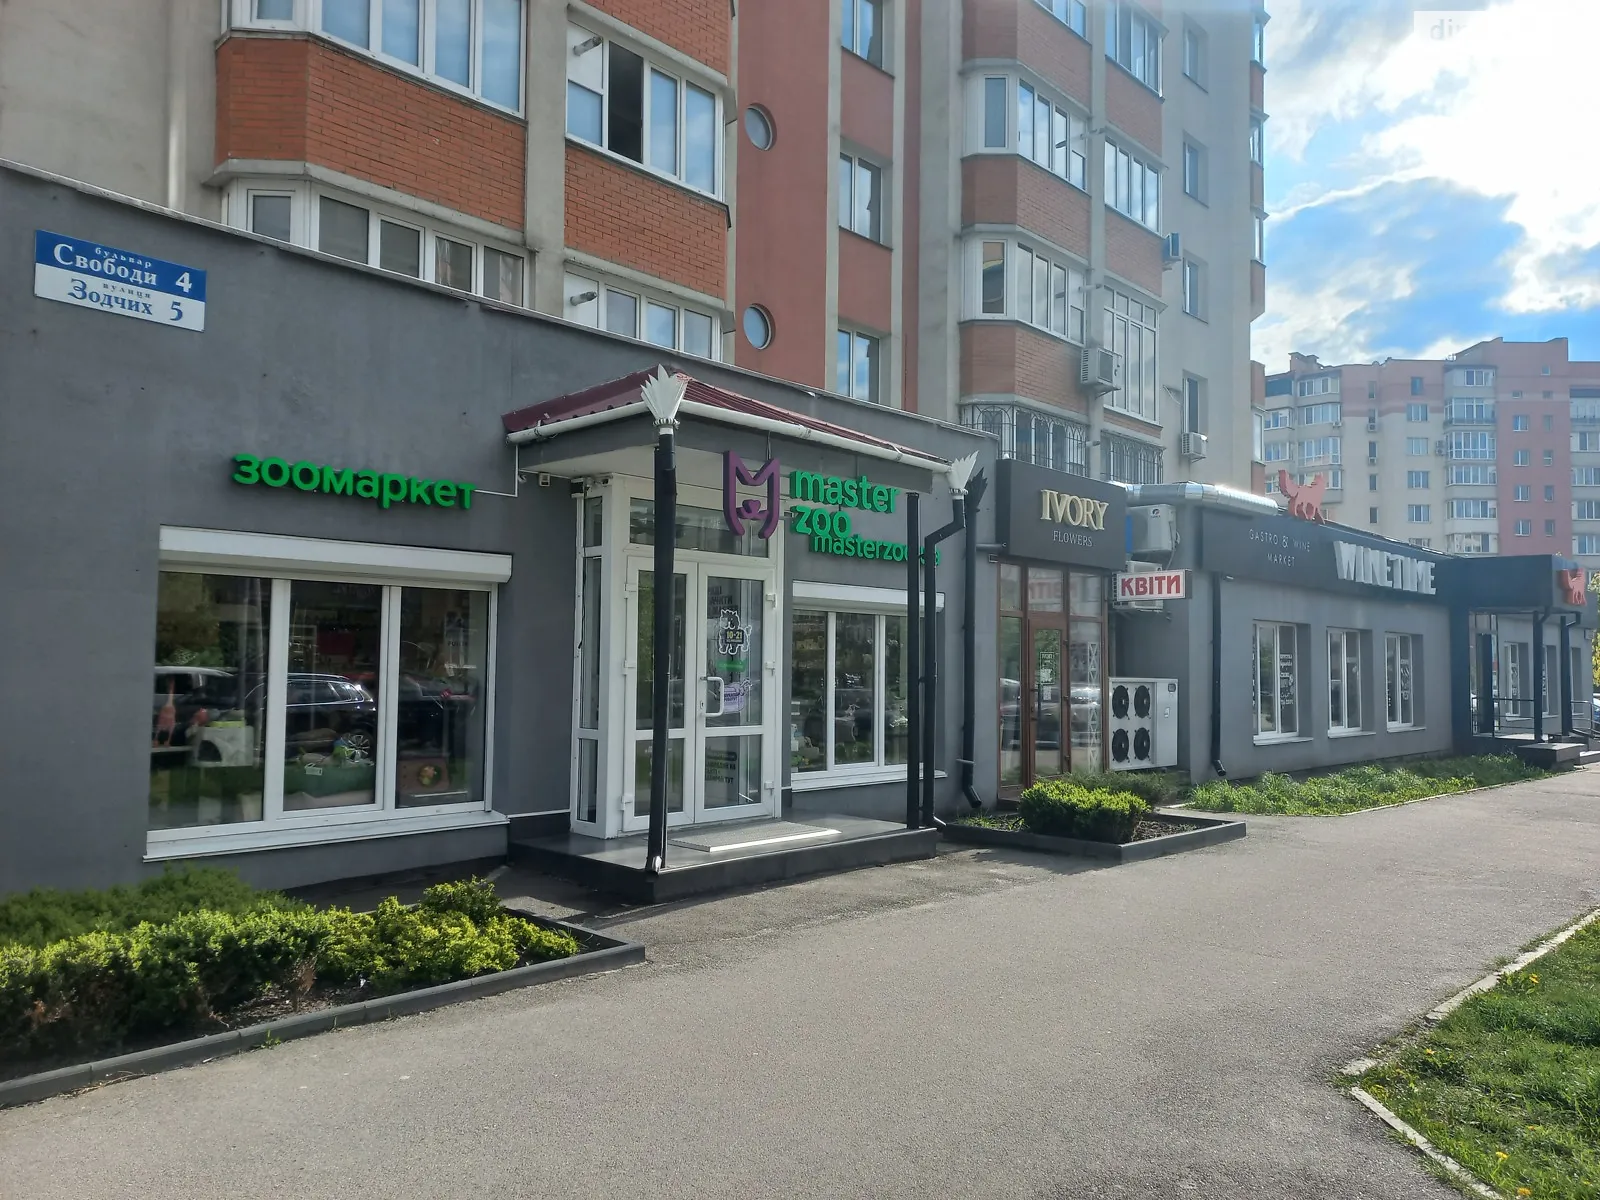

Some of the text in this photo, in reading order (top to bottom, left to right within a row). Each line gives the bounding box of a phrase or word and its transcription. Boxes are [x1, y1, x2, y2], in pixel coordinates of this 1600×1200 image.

[53, 243, 193, 293] Свободи 4
[95, 247, 153, 268] бульвар
[67, 278, 184, 321] Зодчих 5
[102, 282, 151, 299] вулиця
[231, 454, 477, 509] зоомаркет
[790, 470, 900, 513] master
[791, 505, 851, 538] zoo
[1040, 489, 1109, 530] IVORY
[1053, 530, 1093, 547] FLOWERS
[1248, 528, 1311, 553] GASTRO & WINE
[1266, 553, 1295, 567] MARKET
[1333, 540, 1437, 595] WINETIME
[1121, 574, 1181, 596] КВІТИ
